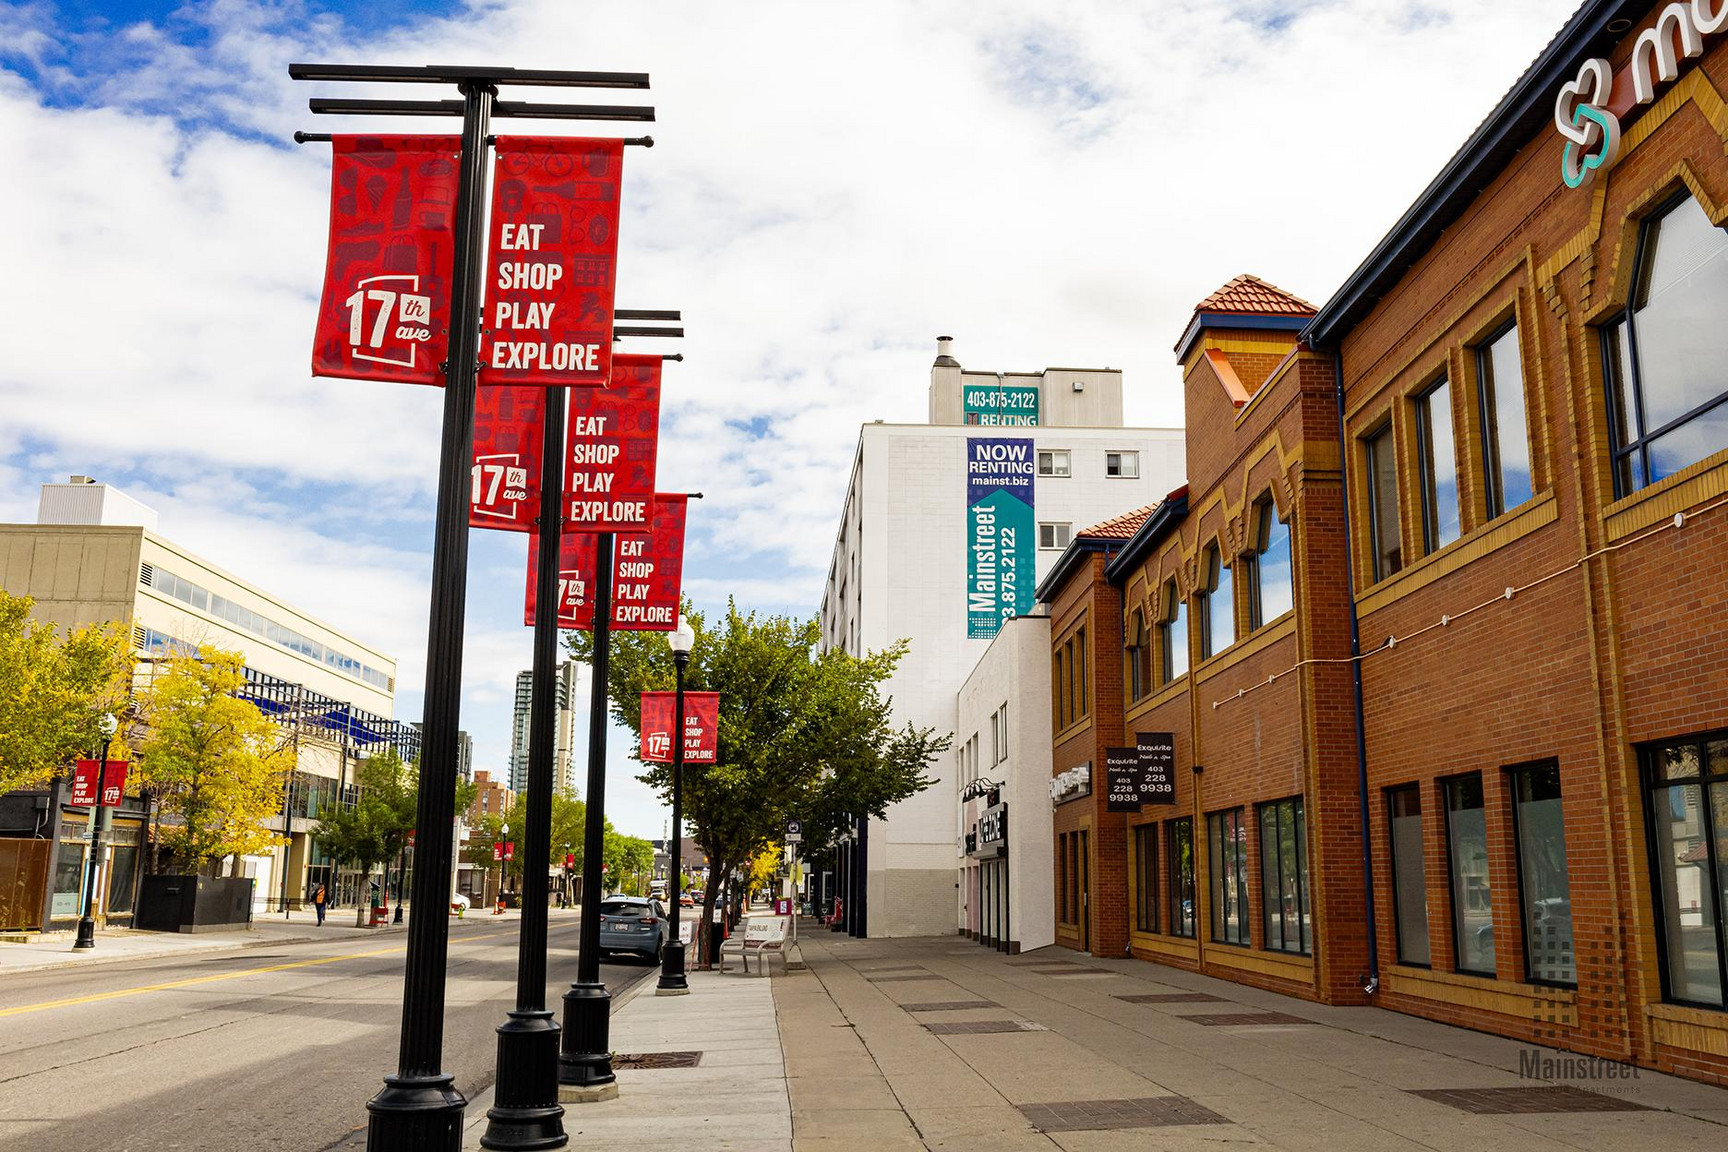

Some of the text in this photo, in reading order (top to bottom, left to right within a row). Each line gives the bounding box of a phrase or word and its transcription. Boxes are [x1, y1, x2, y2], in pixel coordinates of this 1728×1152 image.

[500, 223, 545, 250] EAT
[497, 262, 563, 290] SHOP
[495, 302, 555, 329] PLAY
[395, 325, 431, 341] ave
[491, 341, 600, 371] EXPLORE
[967, 391, 1035, 408] 403-875-2122
[575, 416, 607, 436] EAT
[981, 413, 1036, 427] RENTING
[573, 444, 620, 464] SHOP
[976, 444, 1027, 461] NOW
[969, 461, 1034, 474] RENTING
[572, 472, 614, 492] PLAY
[972, 475, 1029, 486] mainst.biz
[502, 488, 527, 501] ave
[571, 501, 645, 522] EXPLORE
[620, 541, 645, 557] EAT
[968, 505, 996, 612] Mainstreet
[618, 562, 654, 578] SHOP
[1001, 527, 1016, 625] 3.875.2122
[617, 584, 650, 600] PLAY
[565, 596, 584, 606] ave
[616, 606, 673, 623] EXPLORE
[686, 717, 698, 725] EAT
[685, 728, 703, 737] SHOP
[685, 739, 702, 747] PLAY
[684, 750, 713, 758] EXPLORE
[1113, 785, 1133, 793] 228
[1140, 784, 1172, 792] 9938
[1109, 794, 1138, 802] 9938
